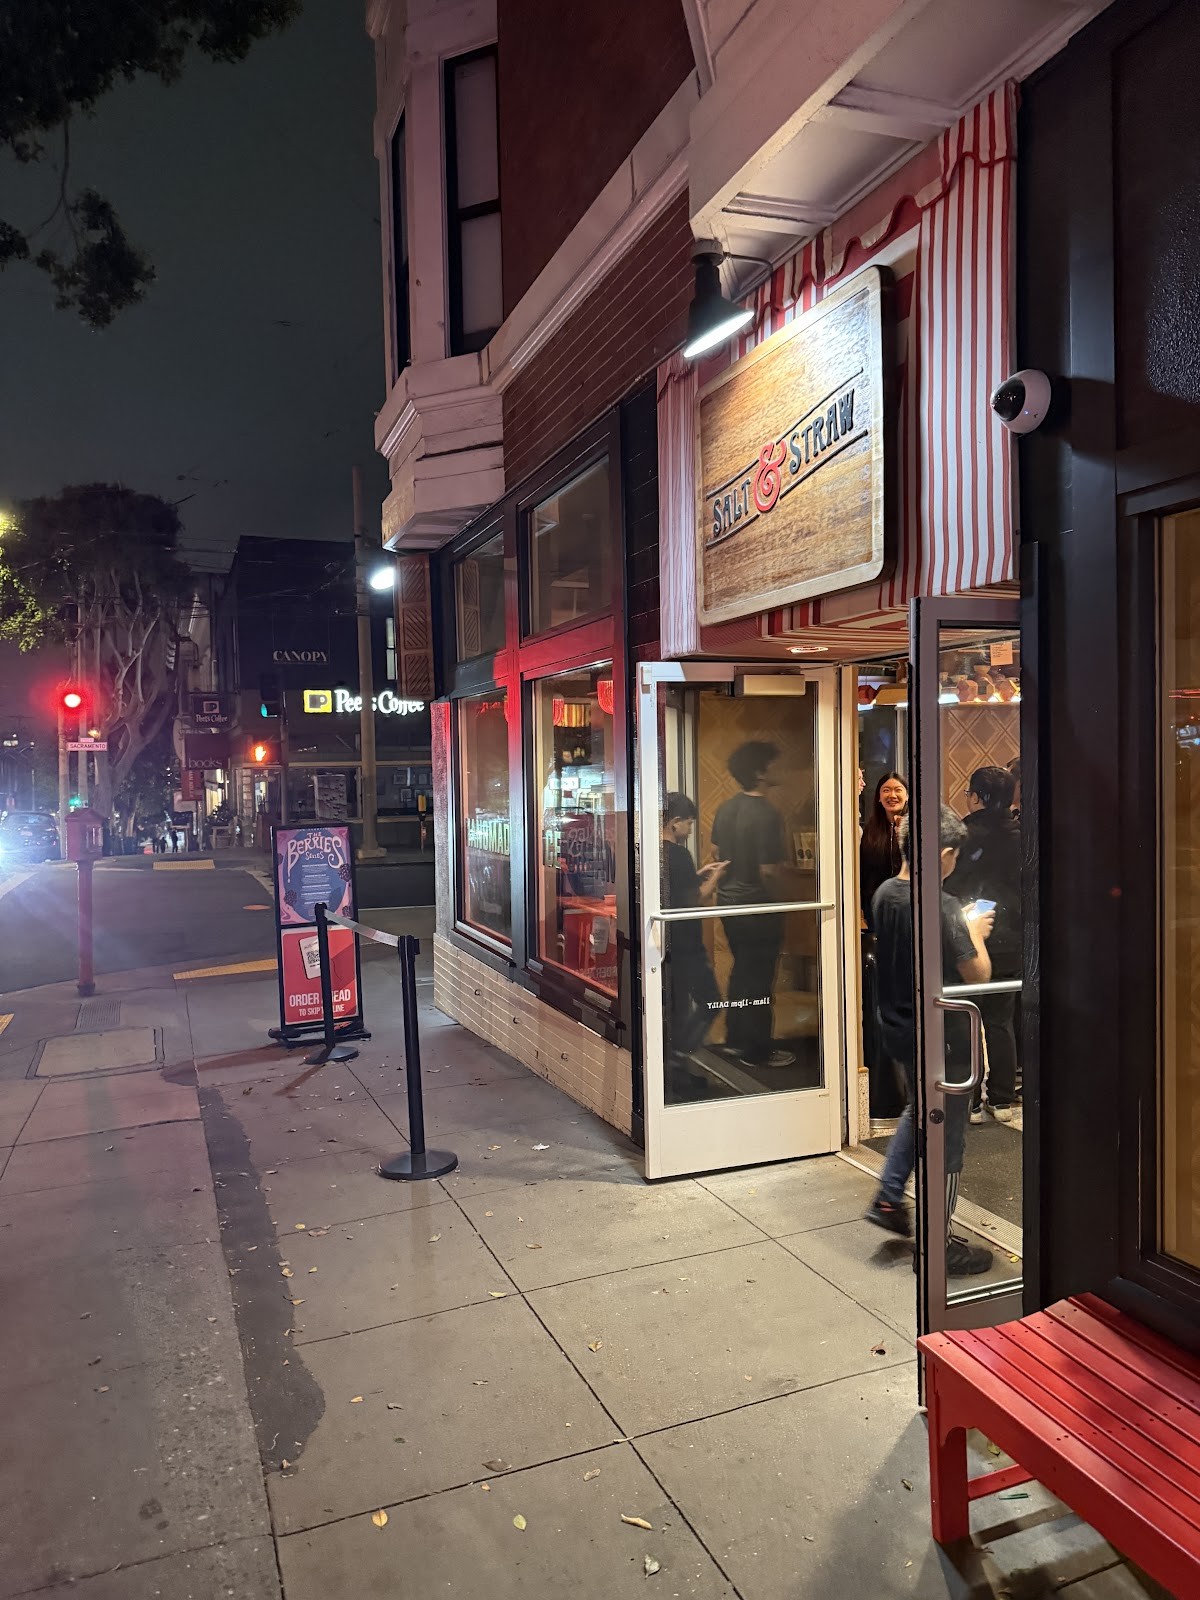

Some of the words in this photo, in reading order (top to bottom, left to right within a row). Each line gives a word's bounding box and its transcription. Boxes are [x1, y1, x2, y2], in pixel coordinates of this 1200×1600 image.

[712, 479, 751, 537] SALT
[753, 440, 786, 513] &
[788, 388, 856, 475] STRAW
[273, 650, 328, 662] CANOPY
[189, 757, 223, 768] books
[287, 836, 344, 883] BERRIES
[289, 992, 320, 1007] ORDER
[299, 1008, 306, 1016] TO
[307, 1007, 320, 1015] SKIP
[333, 1003, 345, 1012] LINE
